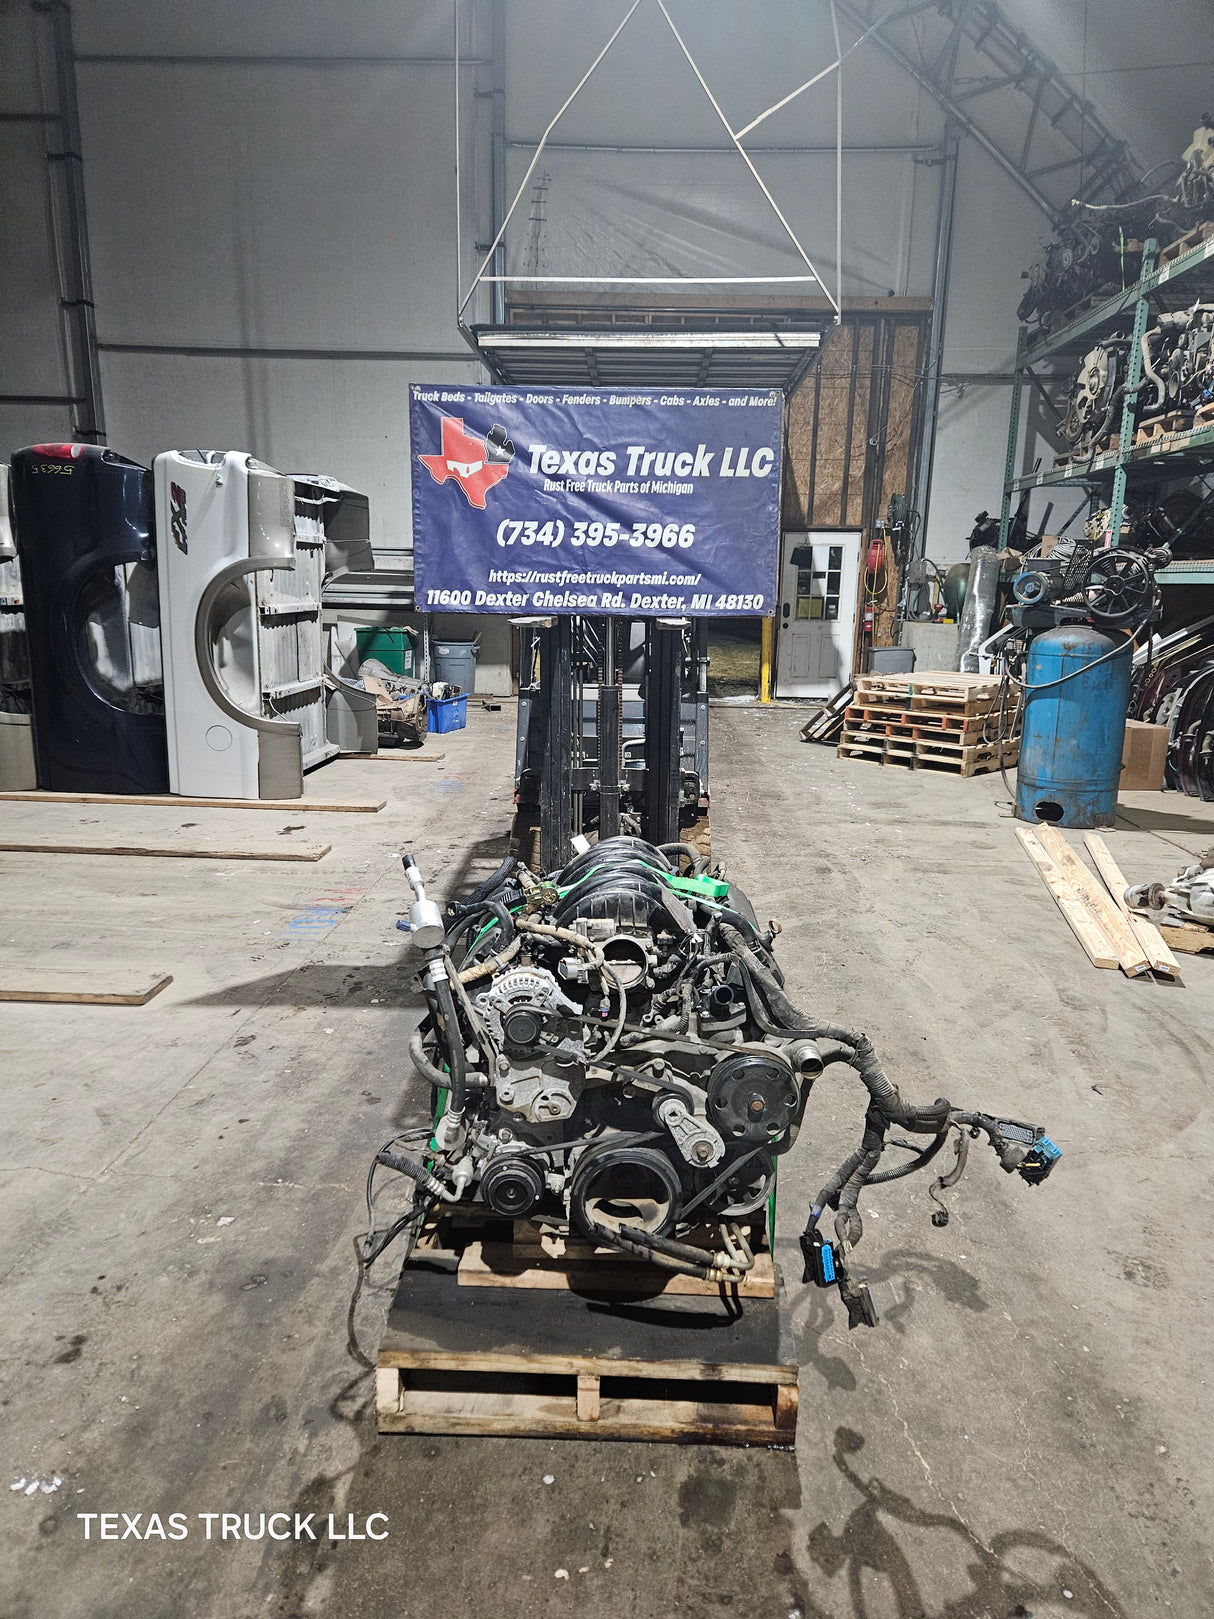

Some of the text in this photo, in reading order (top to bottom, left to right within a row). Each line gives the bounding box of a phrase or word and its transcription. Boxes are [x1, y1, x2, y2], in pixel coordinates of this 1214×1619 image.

[413, 390, 440, 403] Truck
[441, 391, 465, 404] Beds
[474, 391, 517, 406] Tailgates
[526, 393, 553, 405] Doors
[562, 393, 600, 405] Fenders
[609, 394, 652, 408] Bumpers
[660, 395, 684, 406] Cabs
[693, 395, 720, 407] Axles
[728, 395, 747, 407] and
[749, 395, 777, 408] More!
[528, 444, 775, 477] Texas Truck LLC
[543, 479, 694, 496] Rust Free Truck Parts of Michigan
[496, 519, 696, 549] (734) 395-3966
[488, 569, 702, 588] https://rustfreetruckpartsmi.com/
[426, 589, 764, 611] 11600 Dexter Chelsea Rd. Dexter, MI 48130
